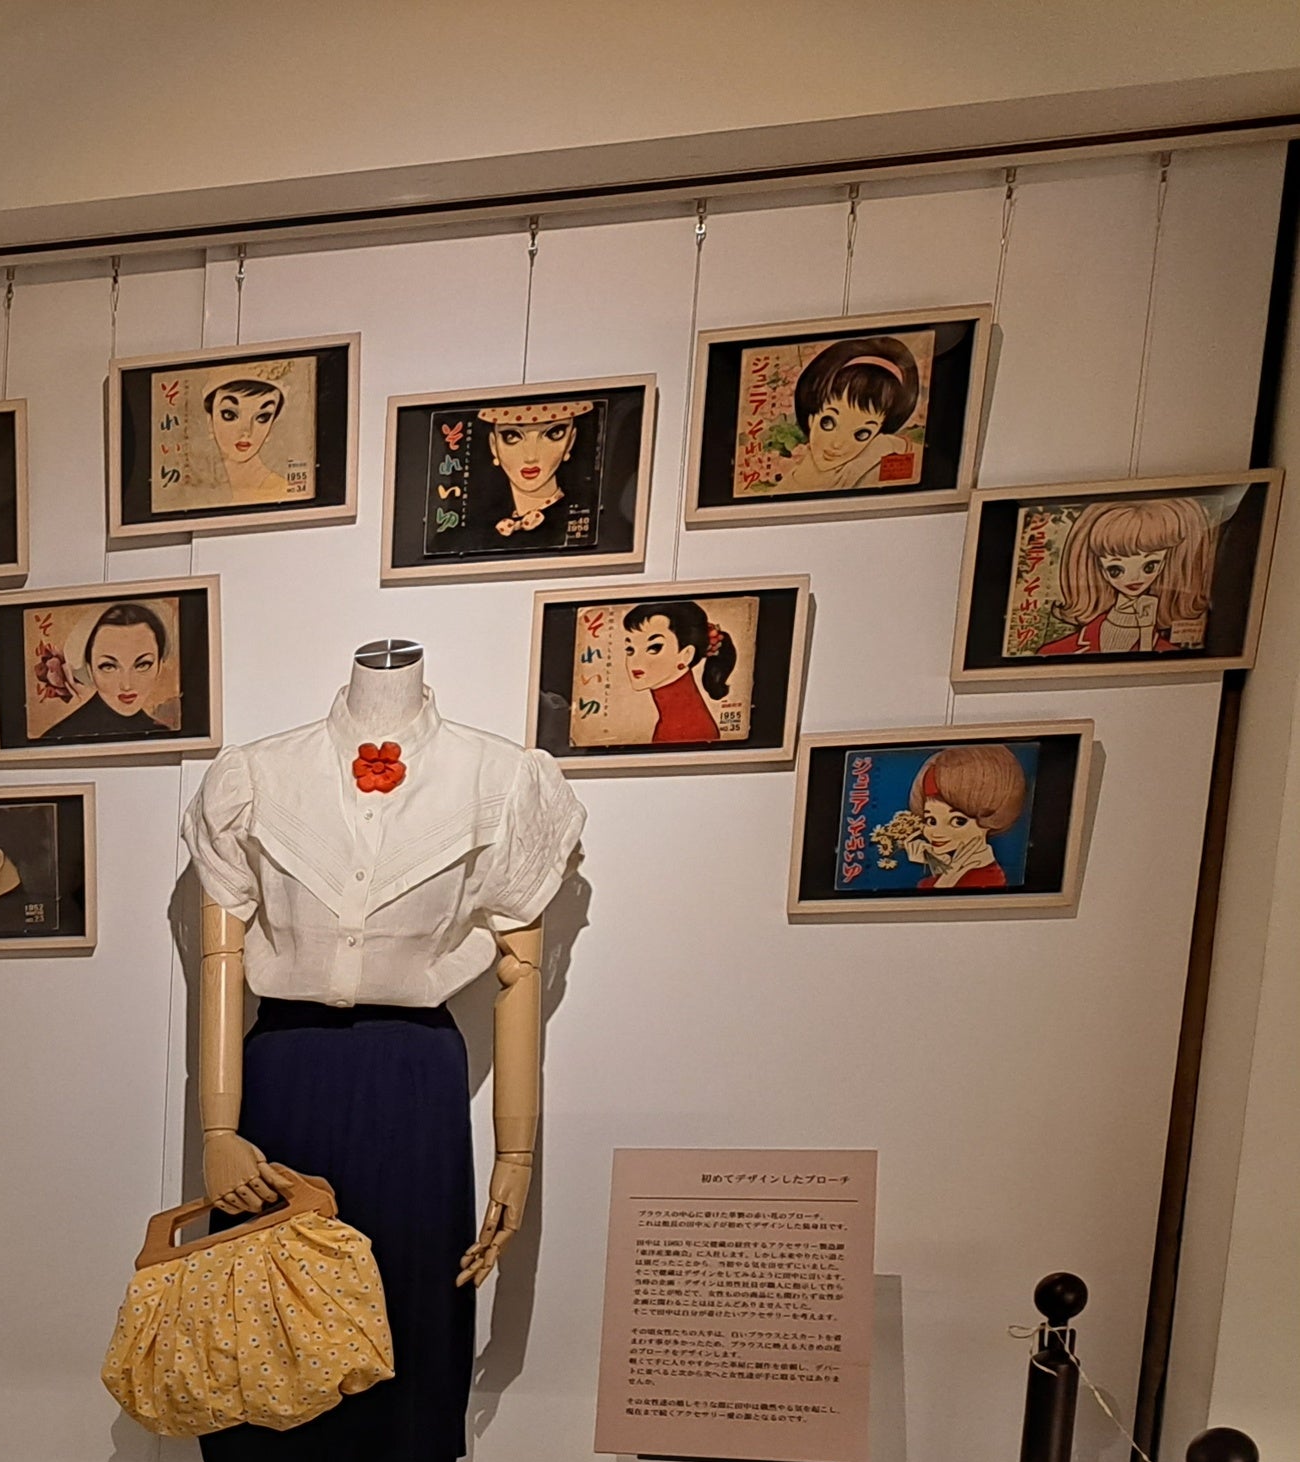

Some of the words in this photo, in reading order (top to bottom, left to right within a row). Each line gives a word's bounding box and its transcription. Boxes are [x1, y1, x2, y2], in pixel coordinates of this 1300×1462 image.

[749, 356, 770, 415] ジュニア
[160, 381, 181, 489] それいゆ
[742, 419, 764, 491] それいゆ
[287, 472, 307, 481] 1955
[436, 421, 465, 533] それいゆ
[1027, 512, 1051, 576] ジュニア
[1016, 576, 1042, 648] それいゆ
[578, 611, 604, 720] それいゆ
[720, 711, 742, 720] 1955
[849, 757, 873, 814] ジュニア
[842, 815, 867, 883] それいゆ
[701, 1174, 848, 1183] 初めてデザインしたブローチ
